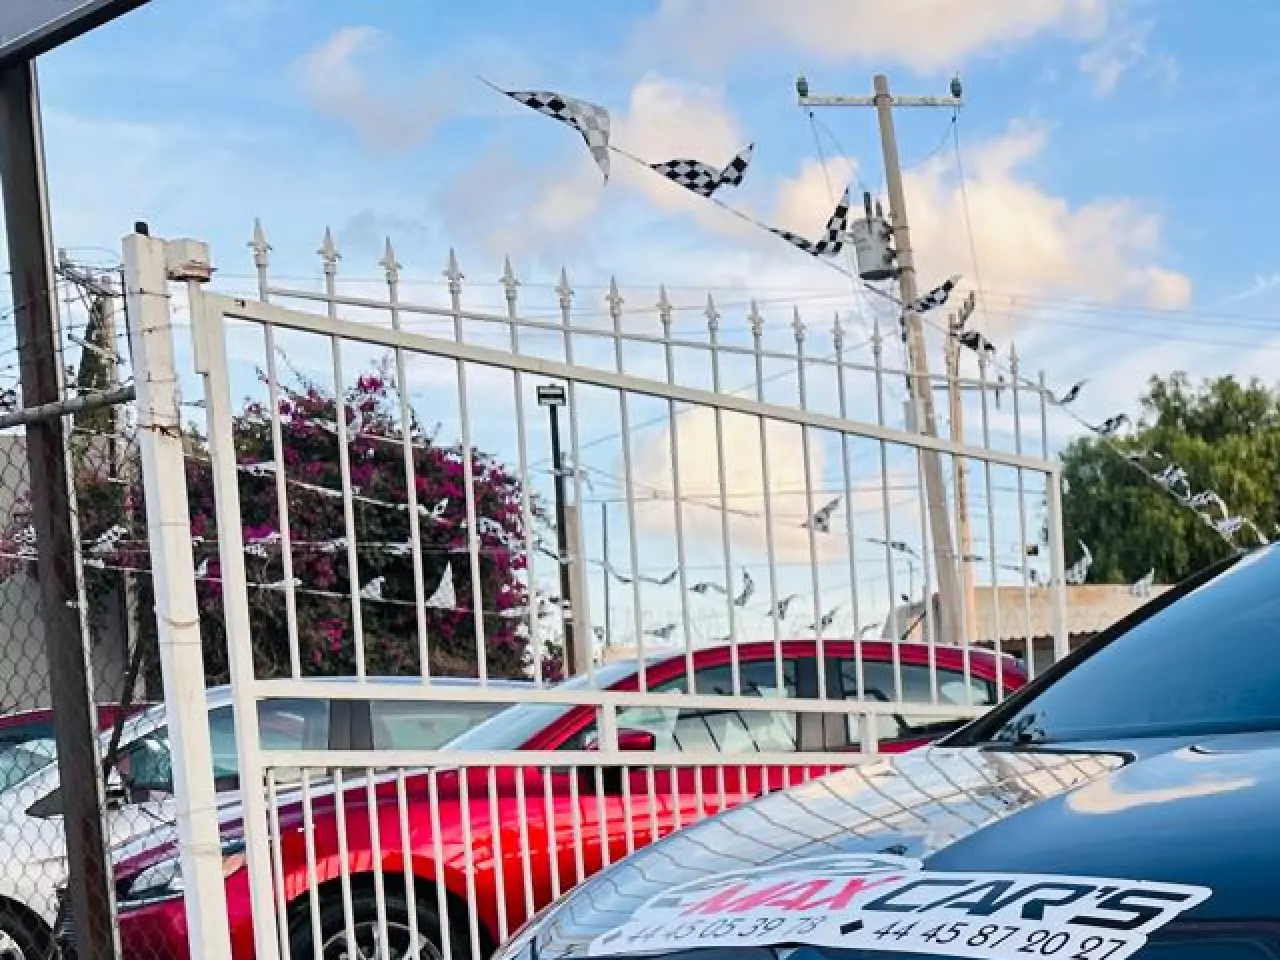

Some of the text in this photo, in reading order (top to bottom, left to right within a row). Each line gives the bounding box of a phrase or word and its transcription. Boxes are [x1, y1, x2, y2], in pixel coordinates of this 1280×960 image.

[679, 876, 1192, 931] MAX CAR'S
[737, 917, 787, 938] 39
[873, 921, 918, 941] 44
[920, 922, 969, 944] 45
[966, 924, 1020, 949] 87
[1018, 929, 1071, 955] 20
